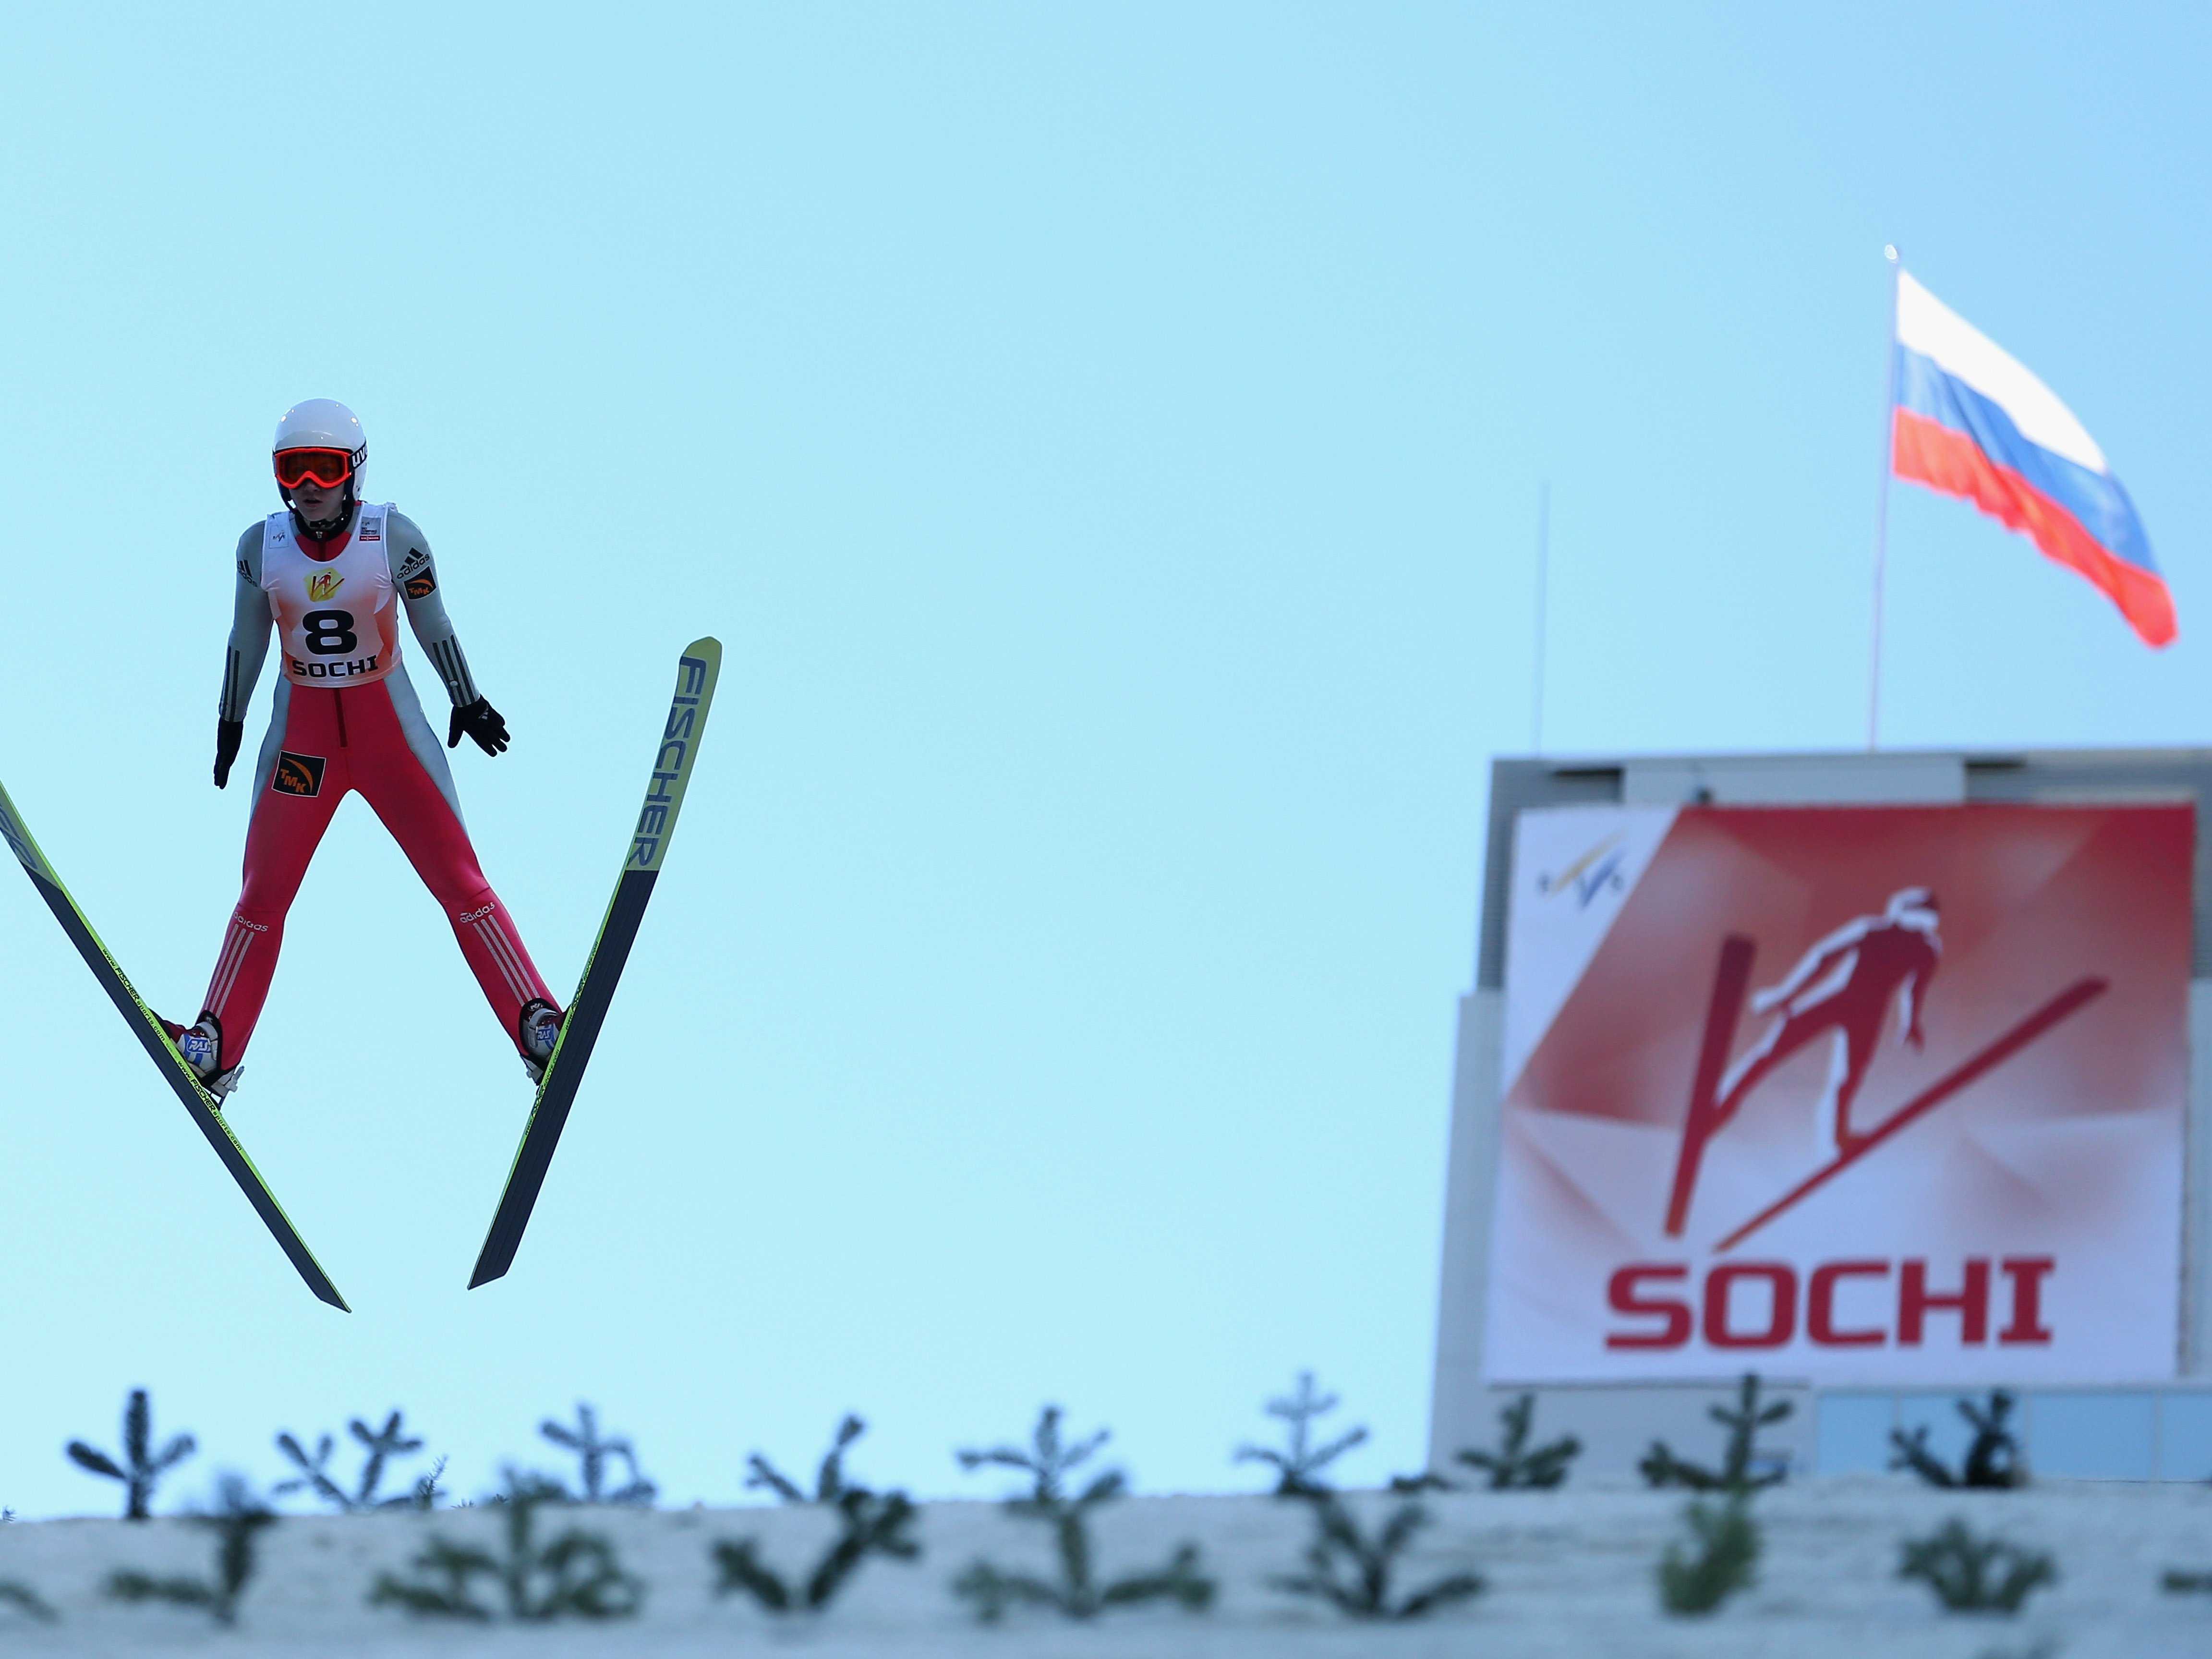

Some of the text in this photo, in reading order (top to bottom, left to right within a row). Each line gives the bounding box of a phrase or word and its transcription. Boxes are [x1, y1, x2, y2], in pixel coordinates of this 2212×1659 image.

[397, 553, 430, 579] adidas
[302, 609, 358, 655] 8
[292, 654, 378, 678] SOCHI
[626, 656, 706, 867] FISCHER
[280, 768, 306, 793] TMK
[233, 911, 268, 932] adidas
[459, 902, 495, 923] adidas
[1605, 1257, 2055, 1350] SOCHI
